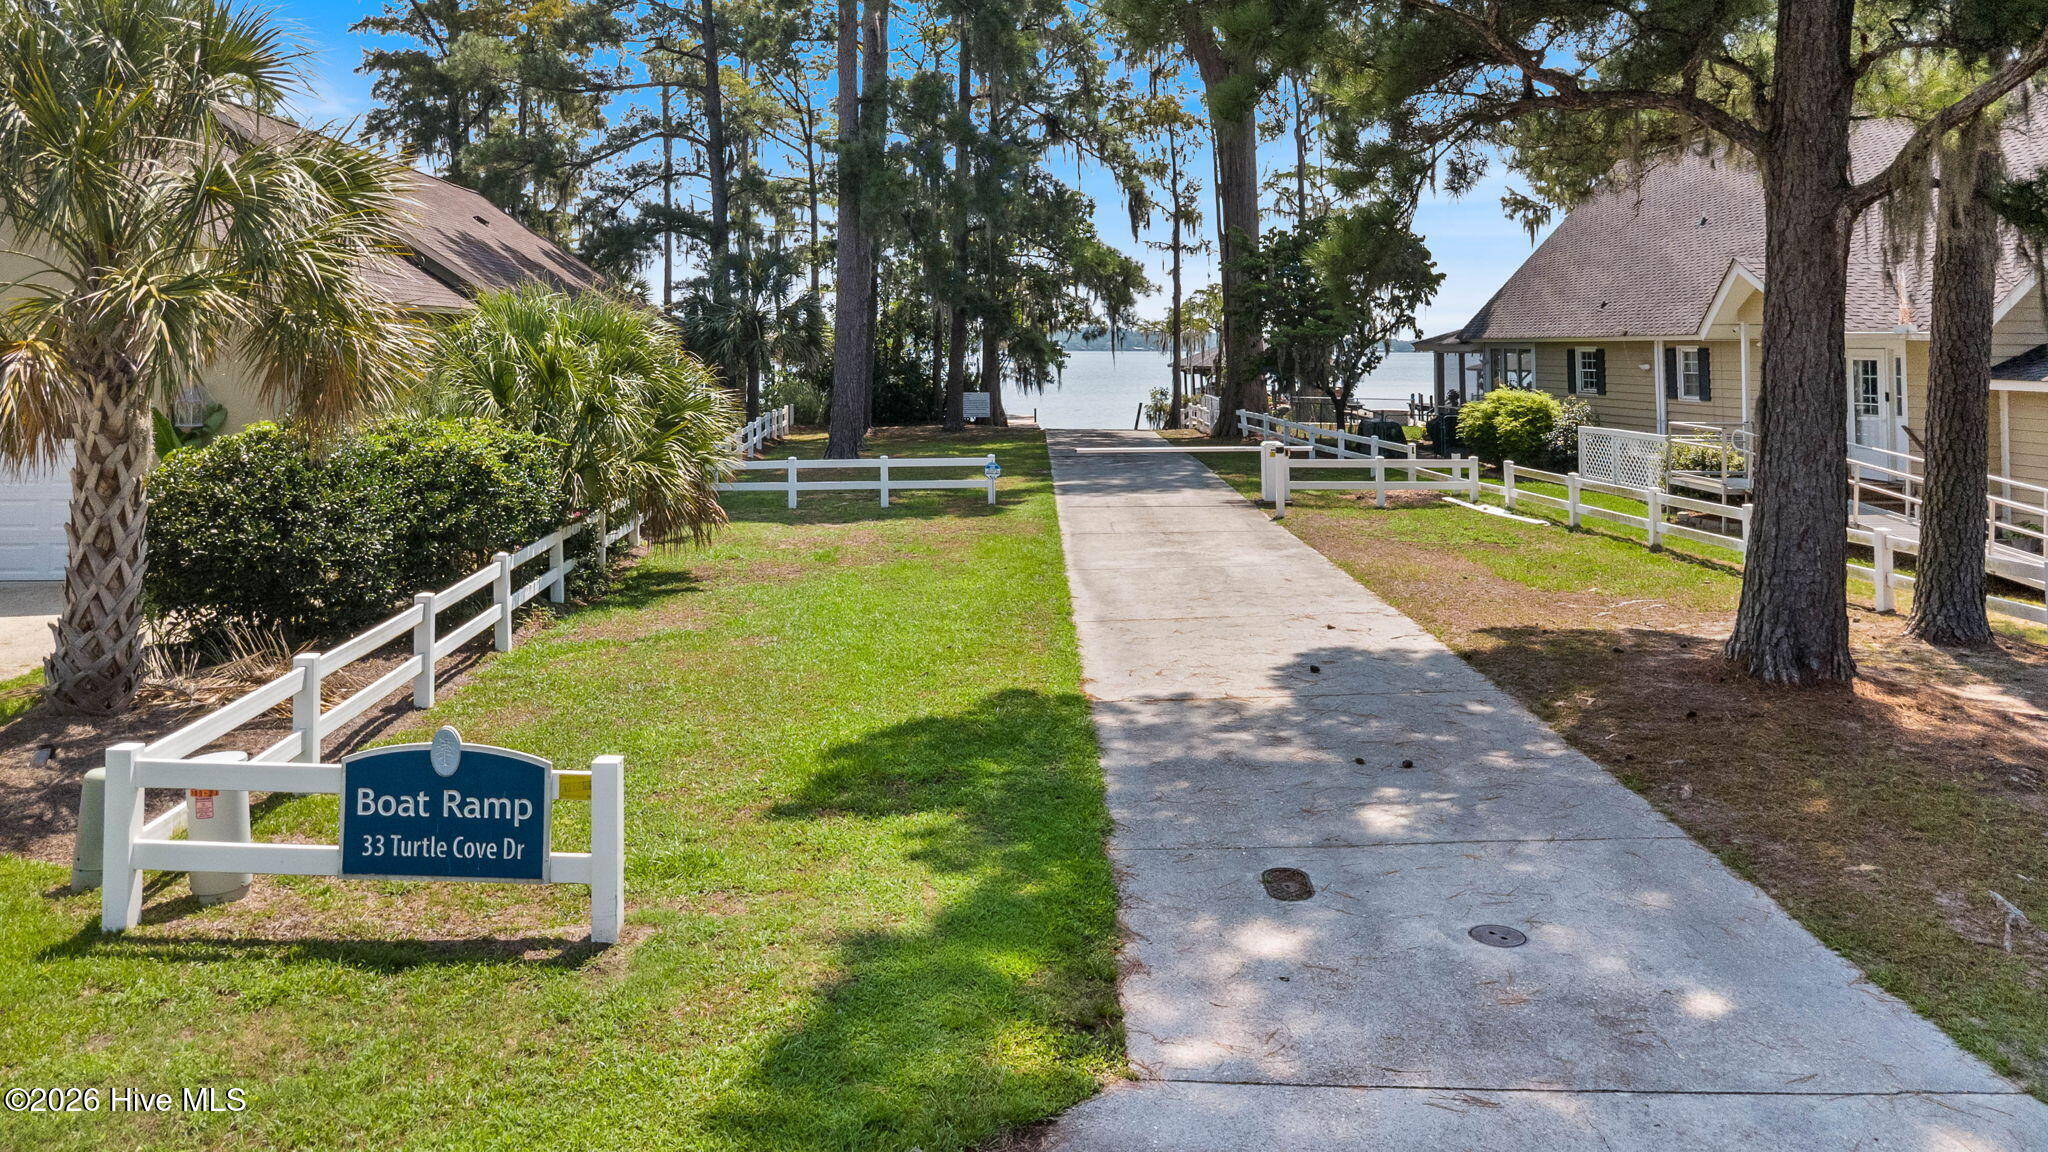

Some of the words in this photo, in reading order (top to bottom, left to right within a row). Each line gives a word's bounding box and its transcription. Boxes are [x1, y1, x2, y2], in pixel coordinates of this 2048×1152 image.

[356, 787, 430, 817] Boat
[442, 789, 533, 827] Ramp
[361, 834, 385, 857] 33
[390, 834, 448, 859] Turtle
[453, 836, 497, 859] Cove
[503, 837, 525, 860] Dr
